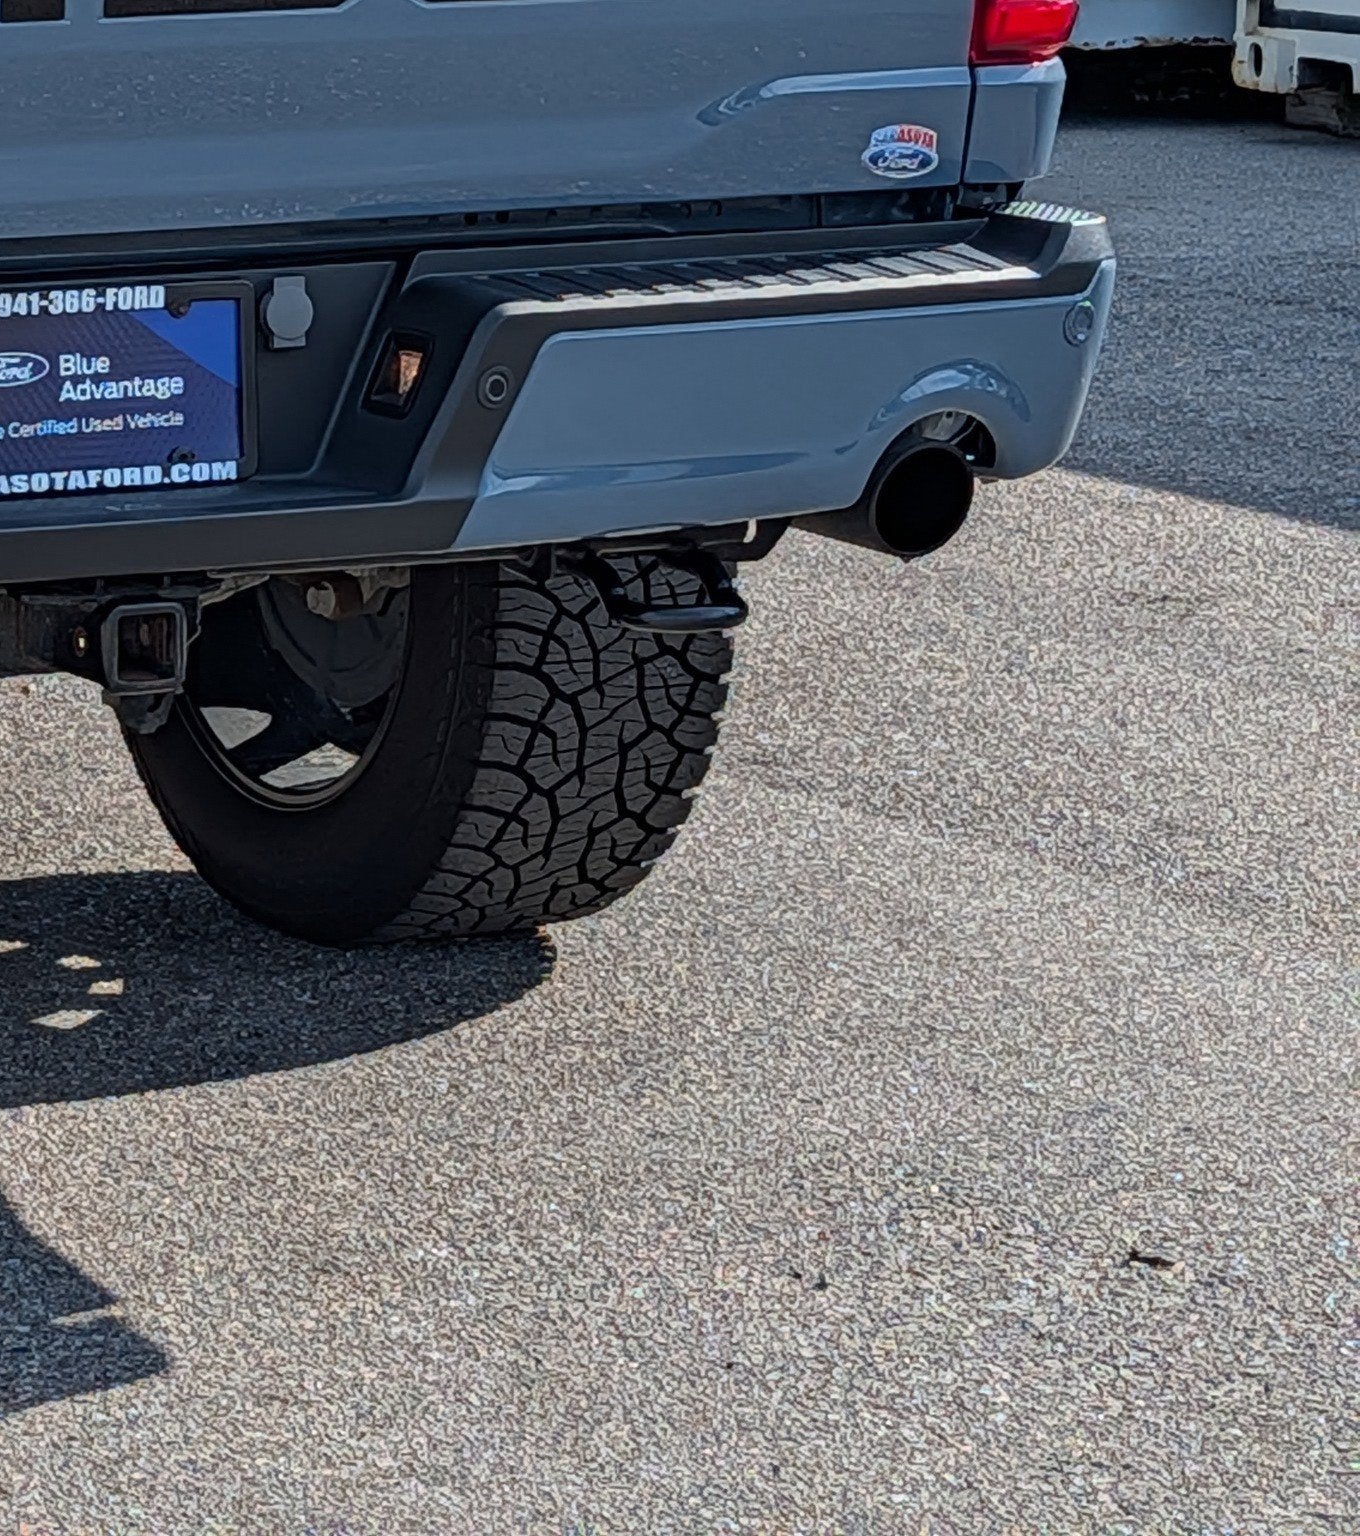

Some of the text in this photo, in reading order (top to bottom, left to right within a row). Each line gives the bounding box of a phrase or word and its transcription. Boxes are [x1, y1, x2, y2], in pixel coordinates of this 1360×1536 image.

[58, 353, 111, 376] Blue
[58, 376, 185, 402] Advantage
[8, 418, 78, 439] Certified
[81, 414, 123, 433] Used
[126, 411, 185, 430] Vehicle
